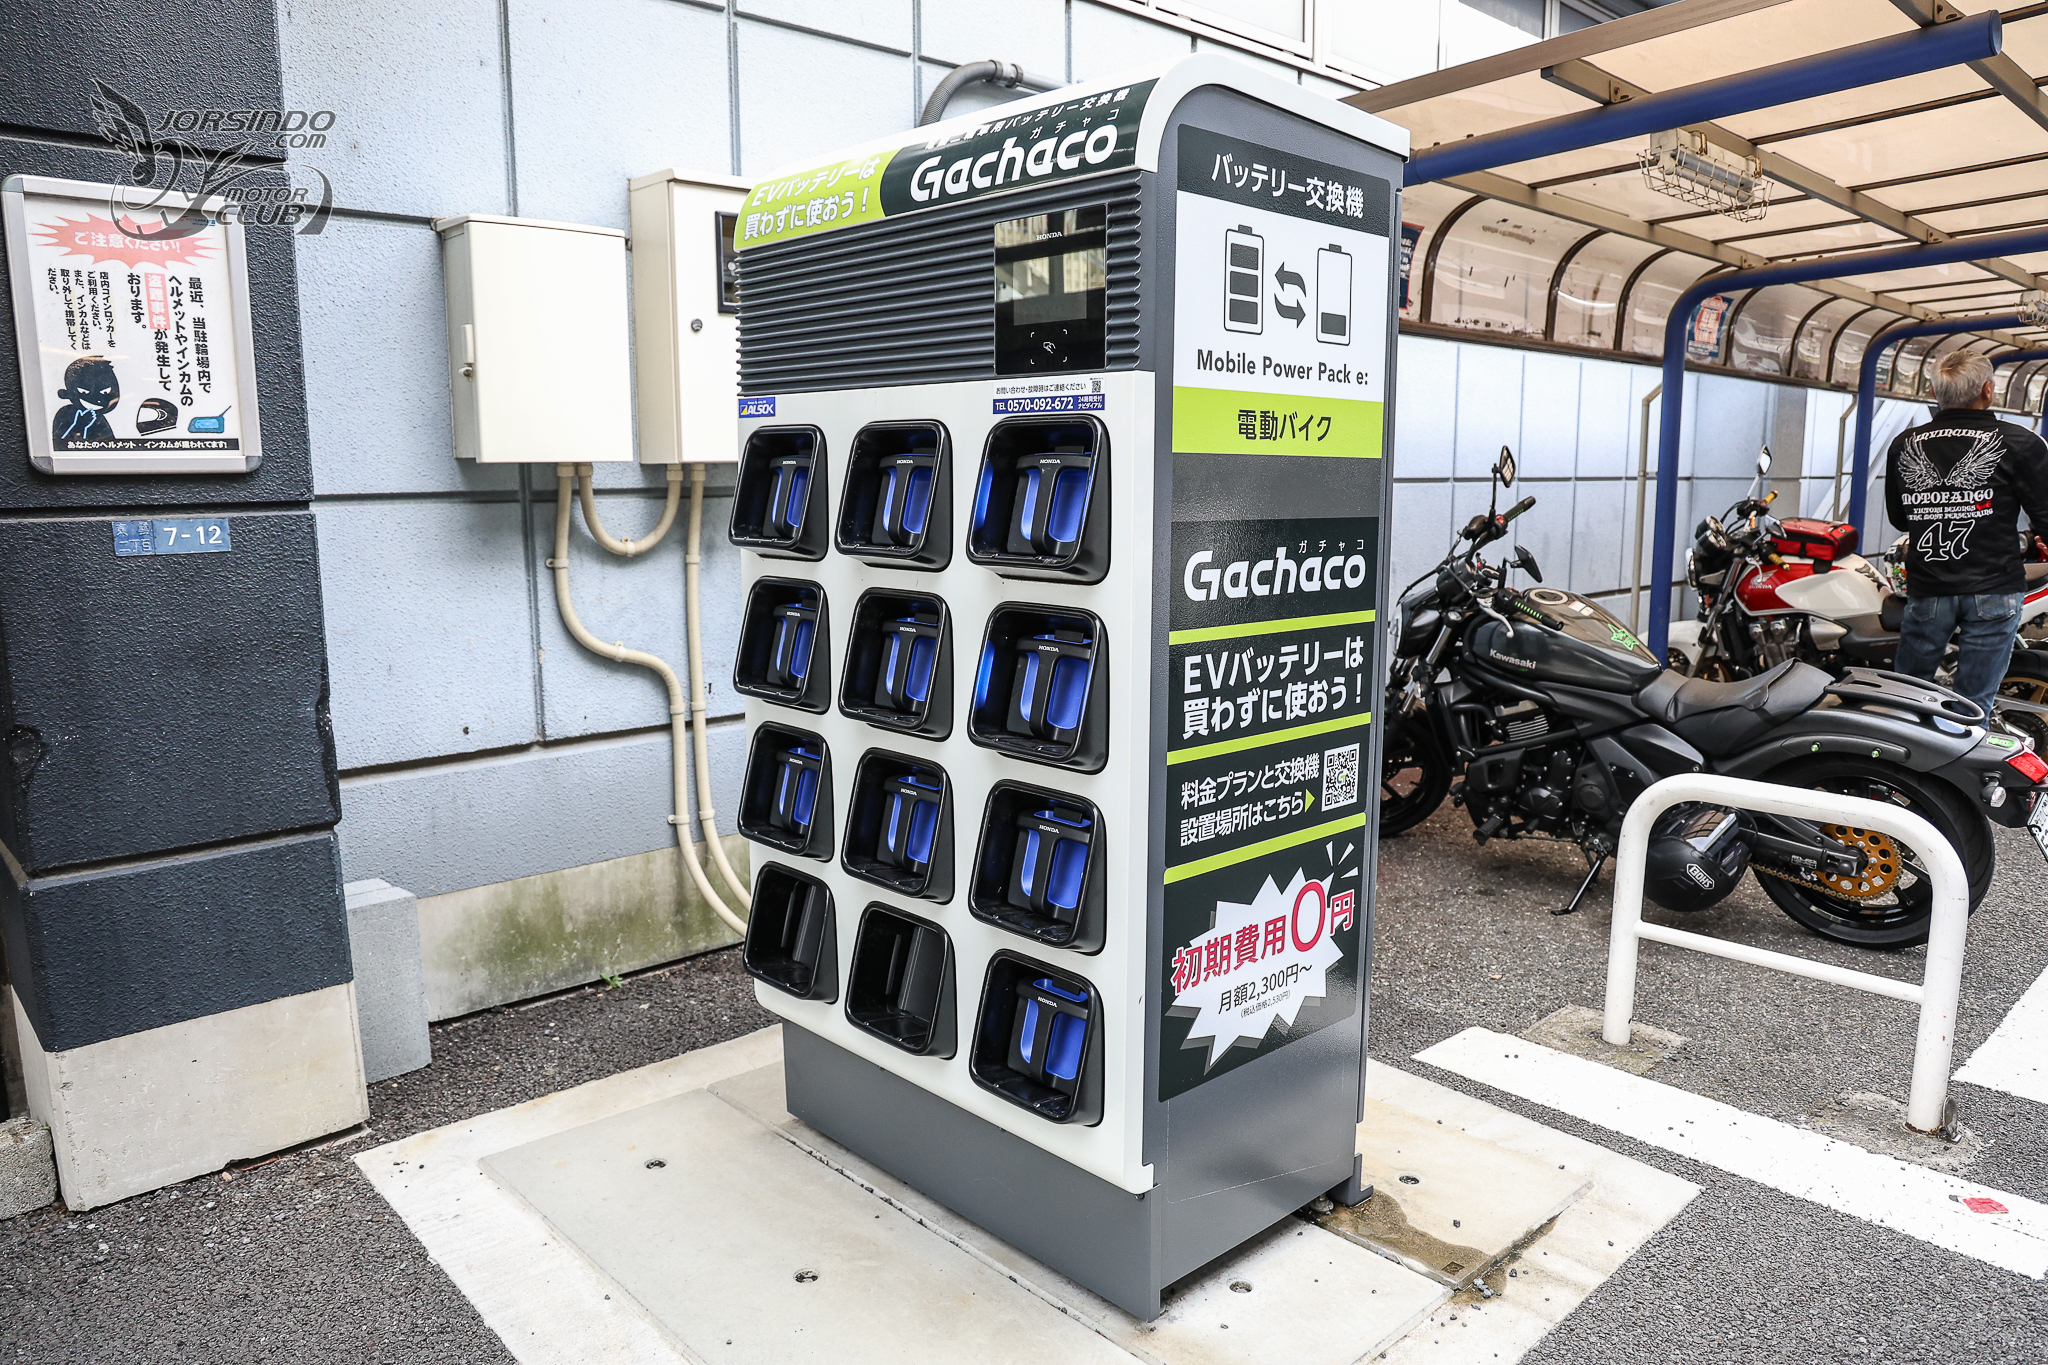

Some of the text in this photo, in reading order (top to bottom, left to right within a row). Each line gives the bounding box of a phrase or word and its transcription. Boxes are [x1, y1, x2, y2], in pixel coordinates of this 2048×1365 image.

[1029, 108, 1120, 140] ガチャコ
[750, 157, 877, 207] EVバッテリーは
[910, 123, 1119, 202] Gachaco
[1210, 152, 1365, 219] バッテリー交換機
[743, 186, 869, 242] 買わずに使おう！
[1036, 231, 1063, 241] HONDA
[73, 230, 181, 254] ご注意ください!
[47, 267, 60, 295] ださい。
[87, 270, 103, 330] ご利用ください。
[127, 272, 147, 329] おります。
[60, 268, 77, 351] 取り外して携帯してく
[99, 271, 116, 348] 店内コインロッカーを
[168, 275, 194, 407] ヘルメットやインカムの
[1196, 348, 1369, 386] Mobile Power Pack e:
[747, 403, 775, 415] ALSOK
[995, 396, 1074, 412] TEL 0570-092-672
[1237, 408, 1333, 442] 電動バイク
[162, 525, 223, 546] 7-12
[1298, 538, 1365, 555] ガチャコ
[1916, 519, 1976, 562] 47
[1183, 546, 1367, 602] Gachaco
[1183, 634, 1365, 694] EVバッテリーは
[1489, 648, 1537, 670] Kawasaki
[1181, 672, 1363, 740] 買わずに使おう！
[1180, 752, 1320, 811] 料金プランと交換機
[1038, 824, 1060, 834] HONDA
[1179, 791, 1304, 847] 設置場所はこちら
[1687, 864, 1714, 889] SHOEI
[1171, 880, 1355, 995] 初期費用0円
[1037, 996, 1058, 1008] HONDA
